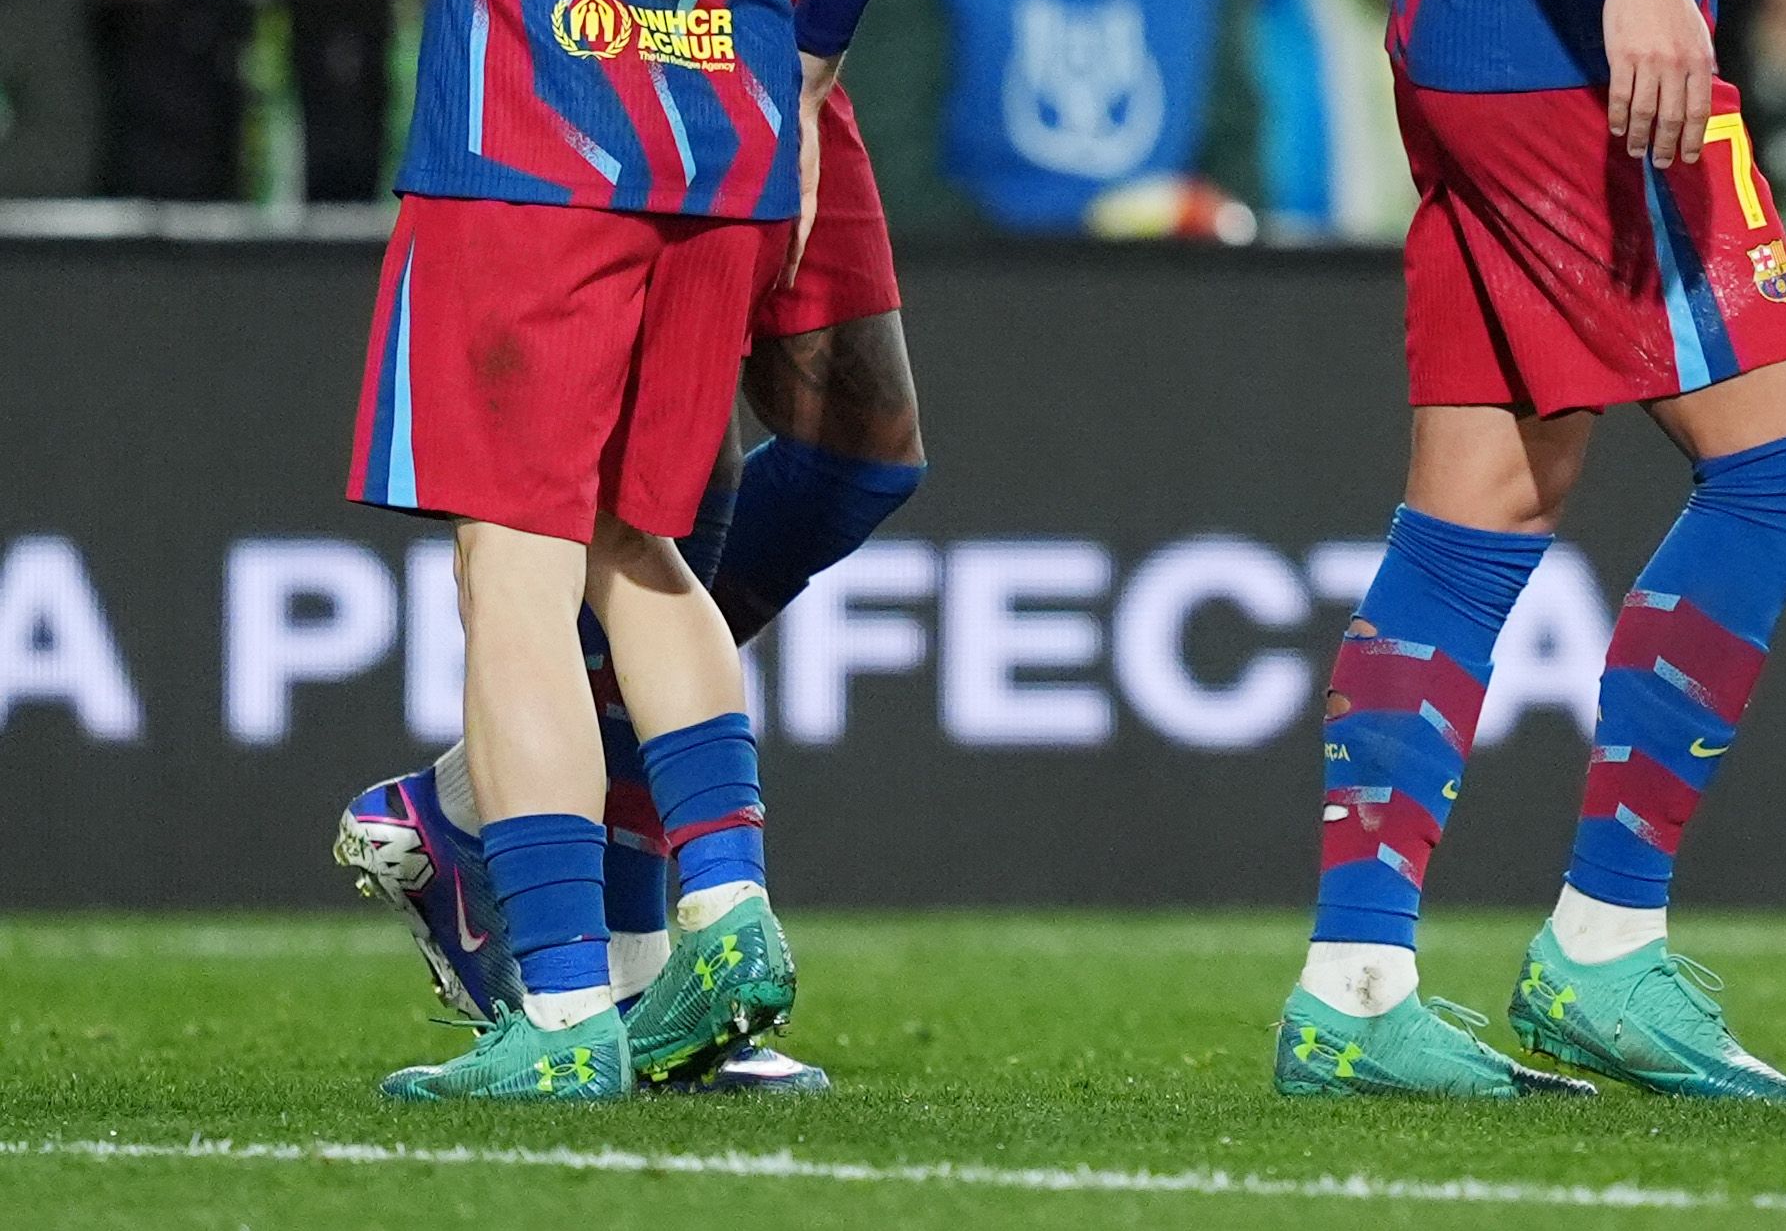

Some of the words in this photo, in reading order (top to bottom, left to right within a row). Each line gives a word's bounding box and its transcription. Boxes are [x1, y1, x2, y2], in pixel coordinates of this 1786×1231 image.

[628, 4, 733, 35] UNHCR
[637, 26, 736, 60] ACNUR
[702, 60, 736, 73] Agency
[1702, 112, 1768, 230] 7
